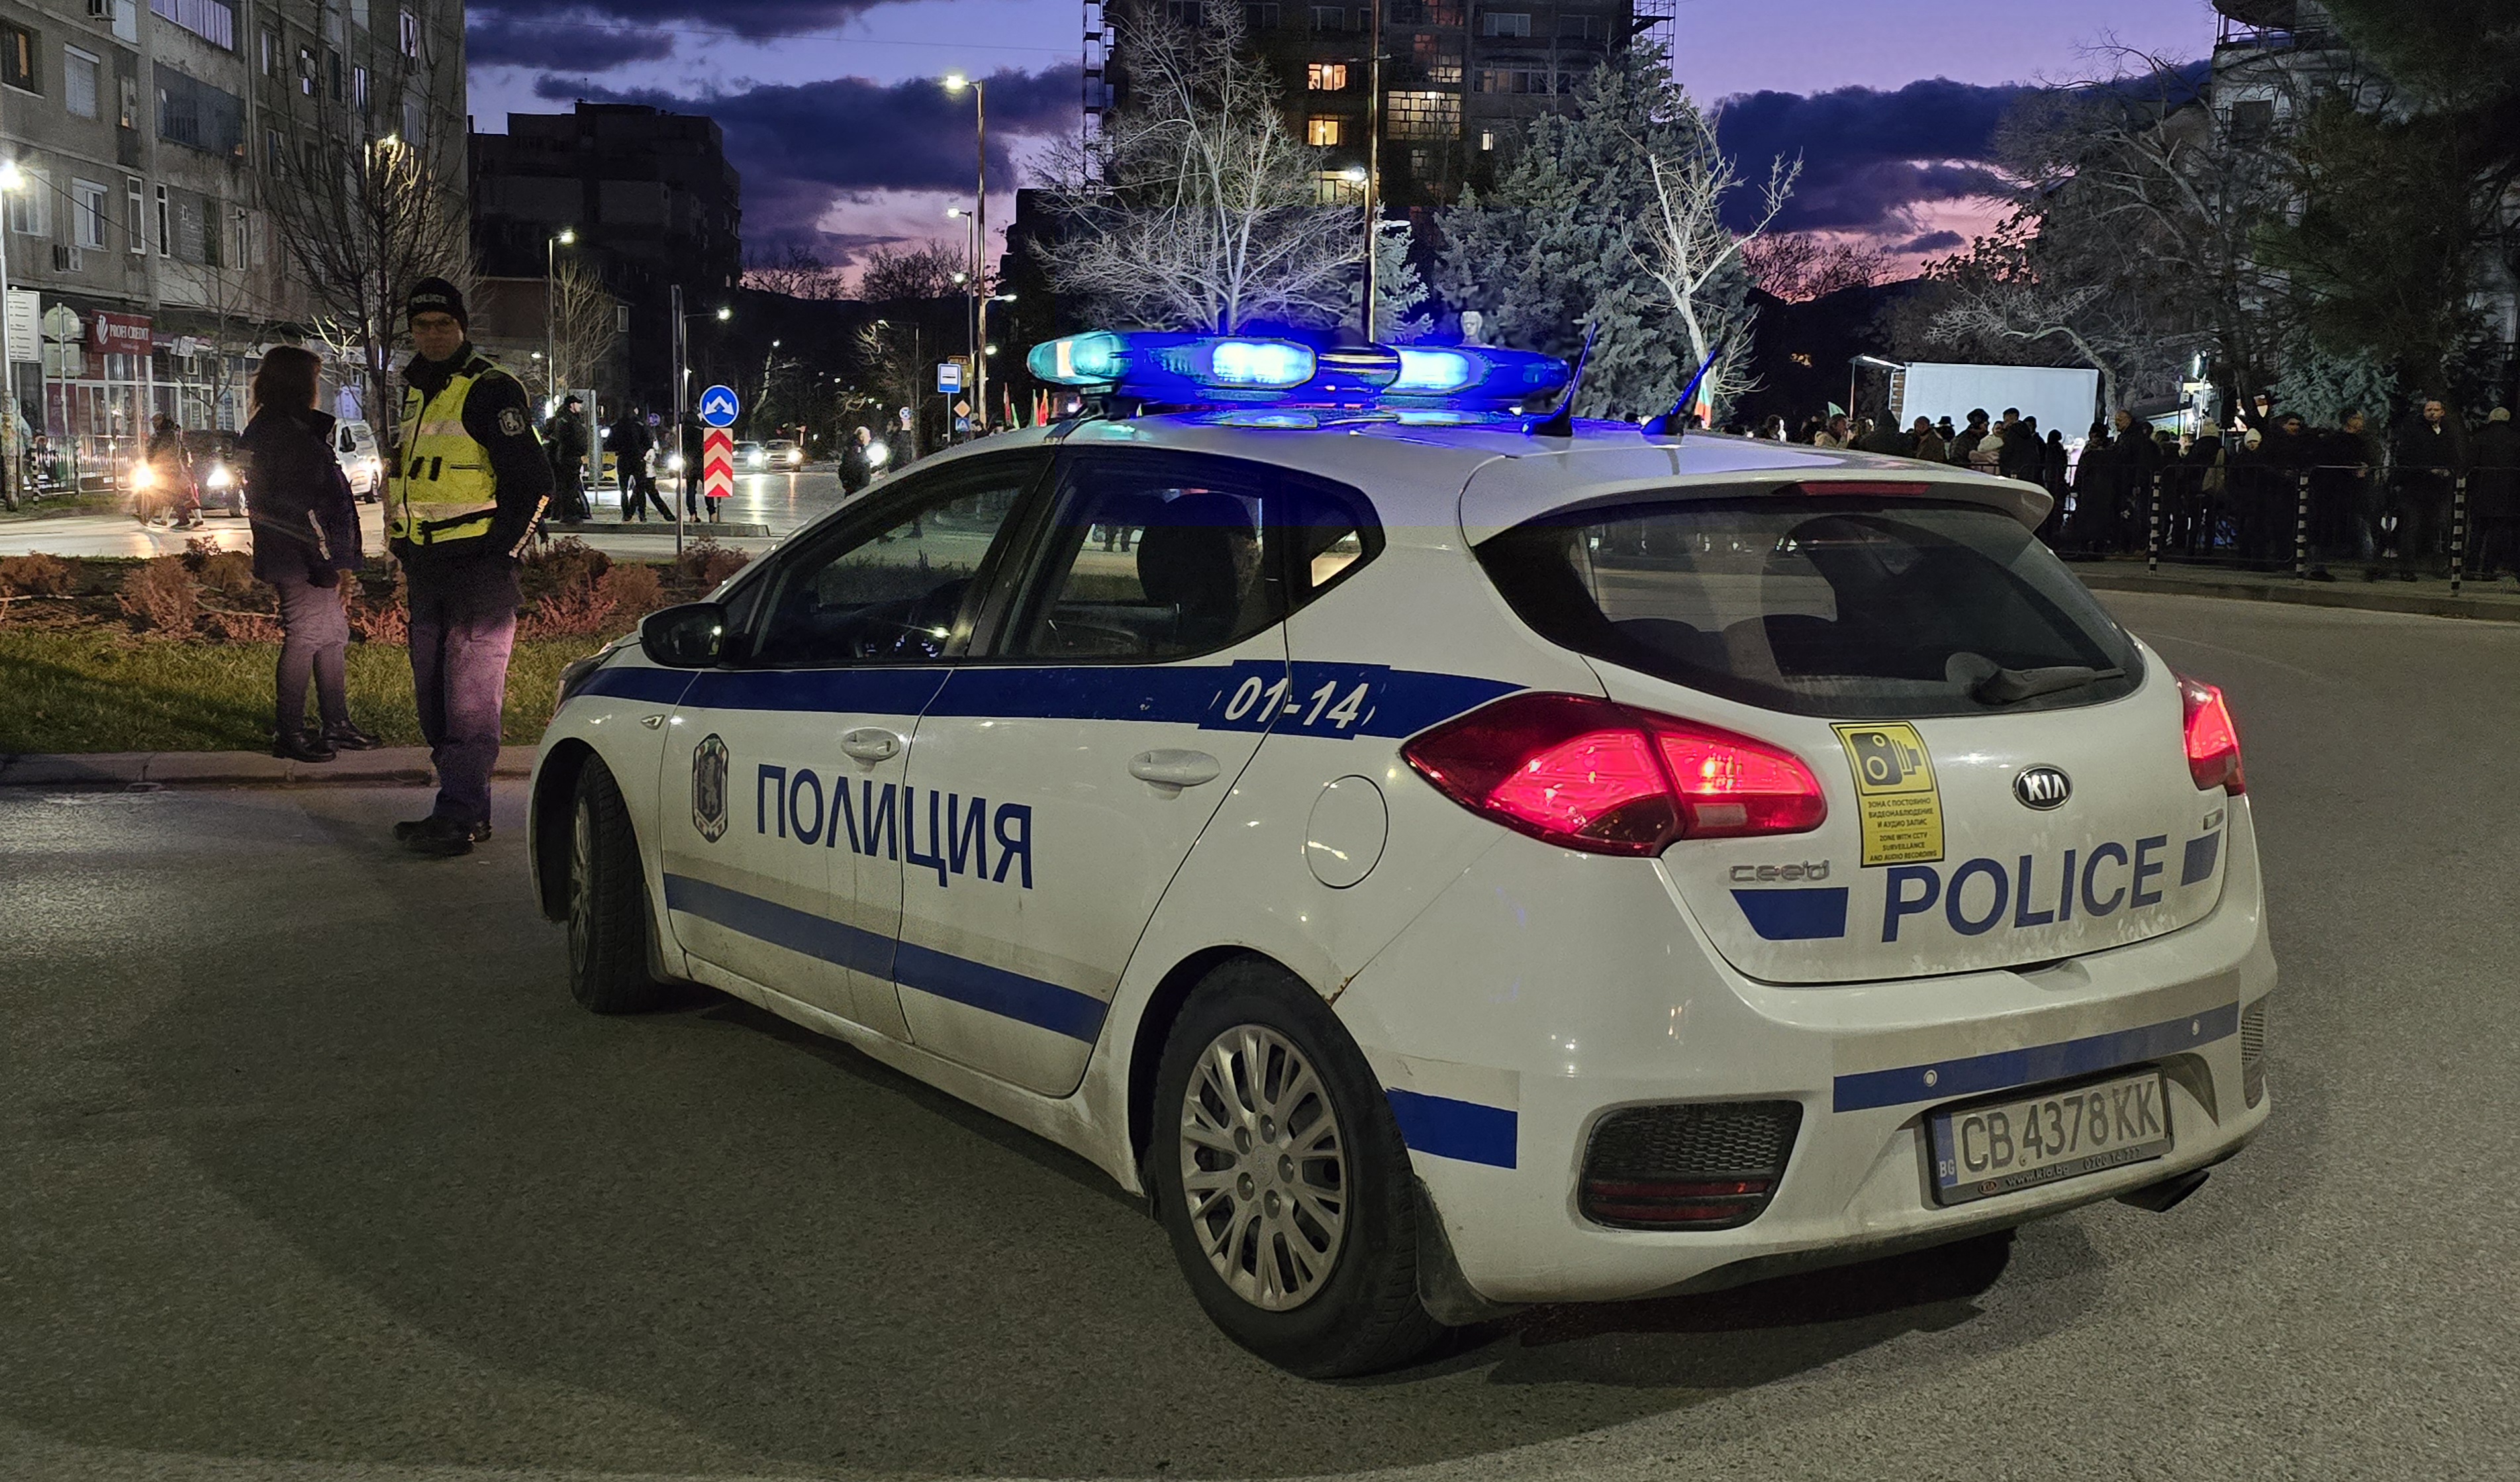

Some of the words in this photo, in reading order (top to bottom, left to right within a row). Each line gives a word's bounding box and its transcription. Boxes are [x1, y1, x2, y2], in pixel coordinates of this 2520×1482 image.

[411, 293, 448, 305] POLICE
[109, 324, 127, 338] PROFI
[128, 326, 149, 340] CREDIT
[1224, 676, 1369, 729] 01-14
[2023, 773, 2067, 801] KIA
[1892, 797, 1931, 807] ПОСТОЯННО
[1868, 808, 1934, 818] ВИДЕОНАБЛЮДЕНИЕ
[757, 764, 1033, 889] ПОЛИЦИЯ
[1883, 820, 1906, 828] АУДИО
[1882, 842, 1925, 851] SURVEILLANCE
[1881, 834, 2168, 943] POLICE
[1939, 1160, 1955, 1178] BG
